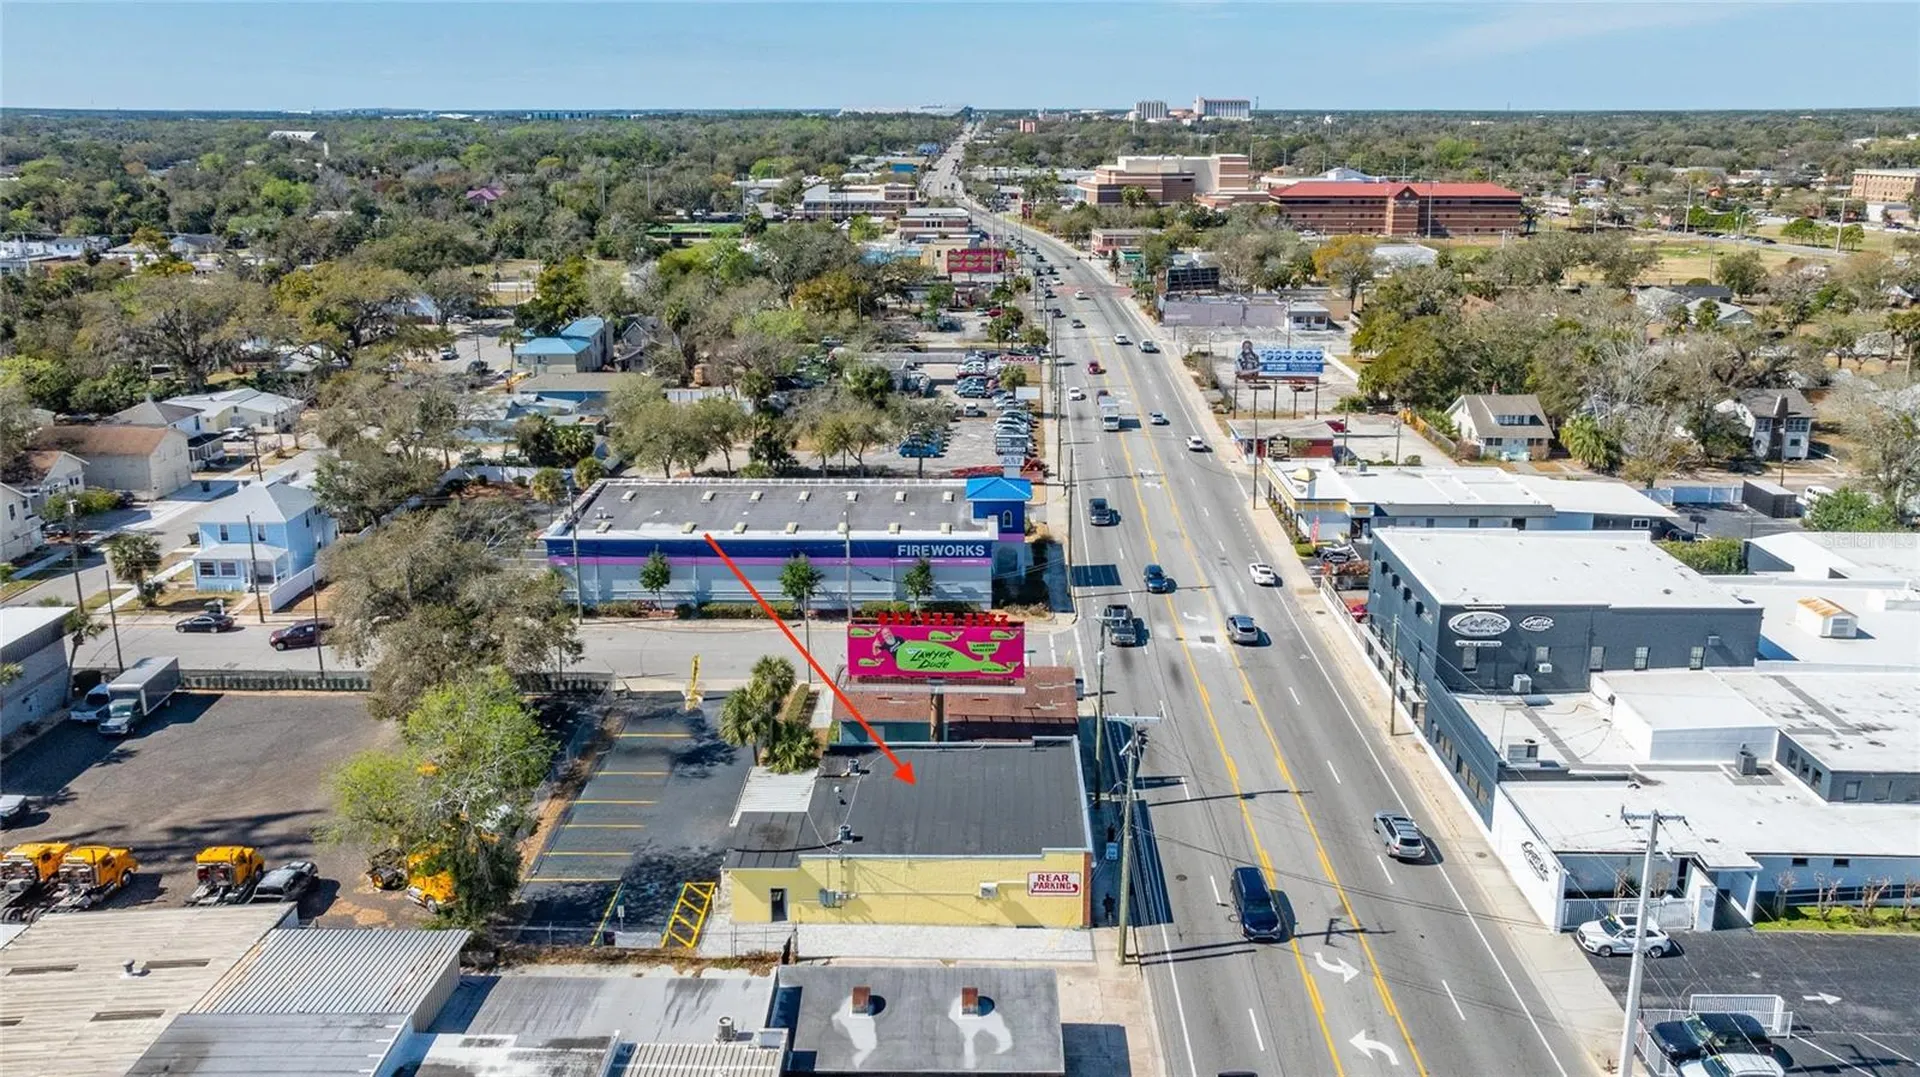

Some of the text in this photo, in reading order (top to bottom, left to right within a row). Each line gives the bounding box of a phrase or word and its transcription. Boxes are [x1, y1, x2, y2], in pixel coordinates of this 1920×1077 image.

[898, 544, 985, 557] FIREWORKS
[1037, 874, 1069, 882] REAR
[1033, 882, 1071, 890] PARKING
